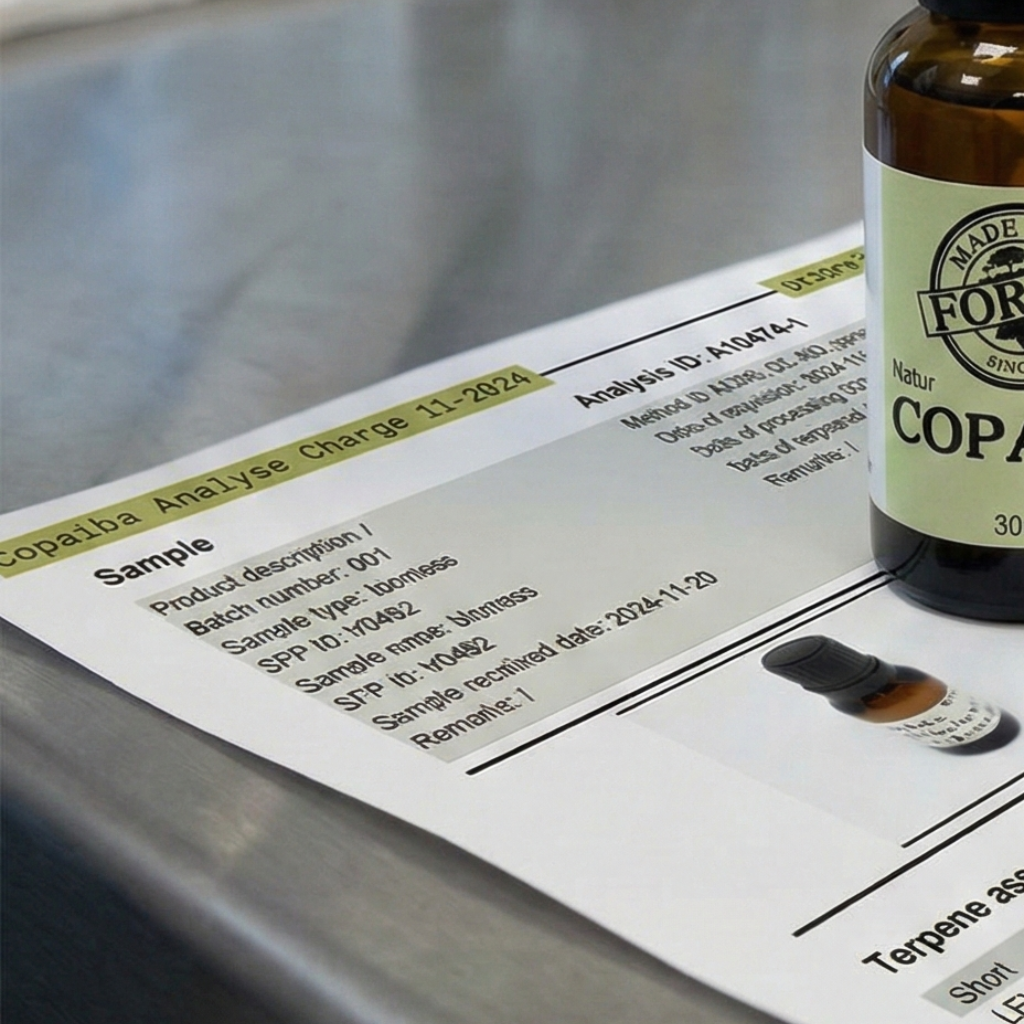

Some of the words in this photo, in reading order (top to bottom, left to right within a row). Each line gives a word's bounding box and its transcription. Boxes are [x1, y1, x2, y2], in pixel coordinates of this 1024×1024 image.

[949, 218, 1019, 271] MADE
[574, 366, 675, 409] Analysis
[705, 317, 810, 361] A10474-1
[892, 358, 936, 392] Natur
[152, 459, 290, 514] Analyse
[299, 416, 410, 460] Charge
[415, 371, 532, 419] 11-2024
[94, 537, 215, 586] Sample
[184, 603, 258, 637] Batch
[256, 566, 350, 610] number:
[346, 547, 392, 573] 001
[149, 574, 245, 617] Product
[555, 617, 613, 651] date:
[604, 569, 719, 627] 2024-11-20
[860, 900, 992, 974] Terpene
[949, 961, 1020, 1005] Short
